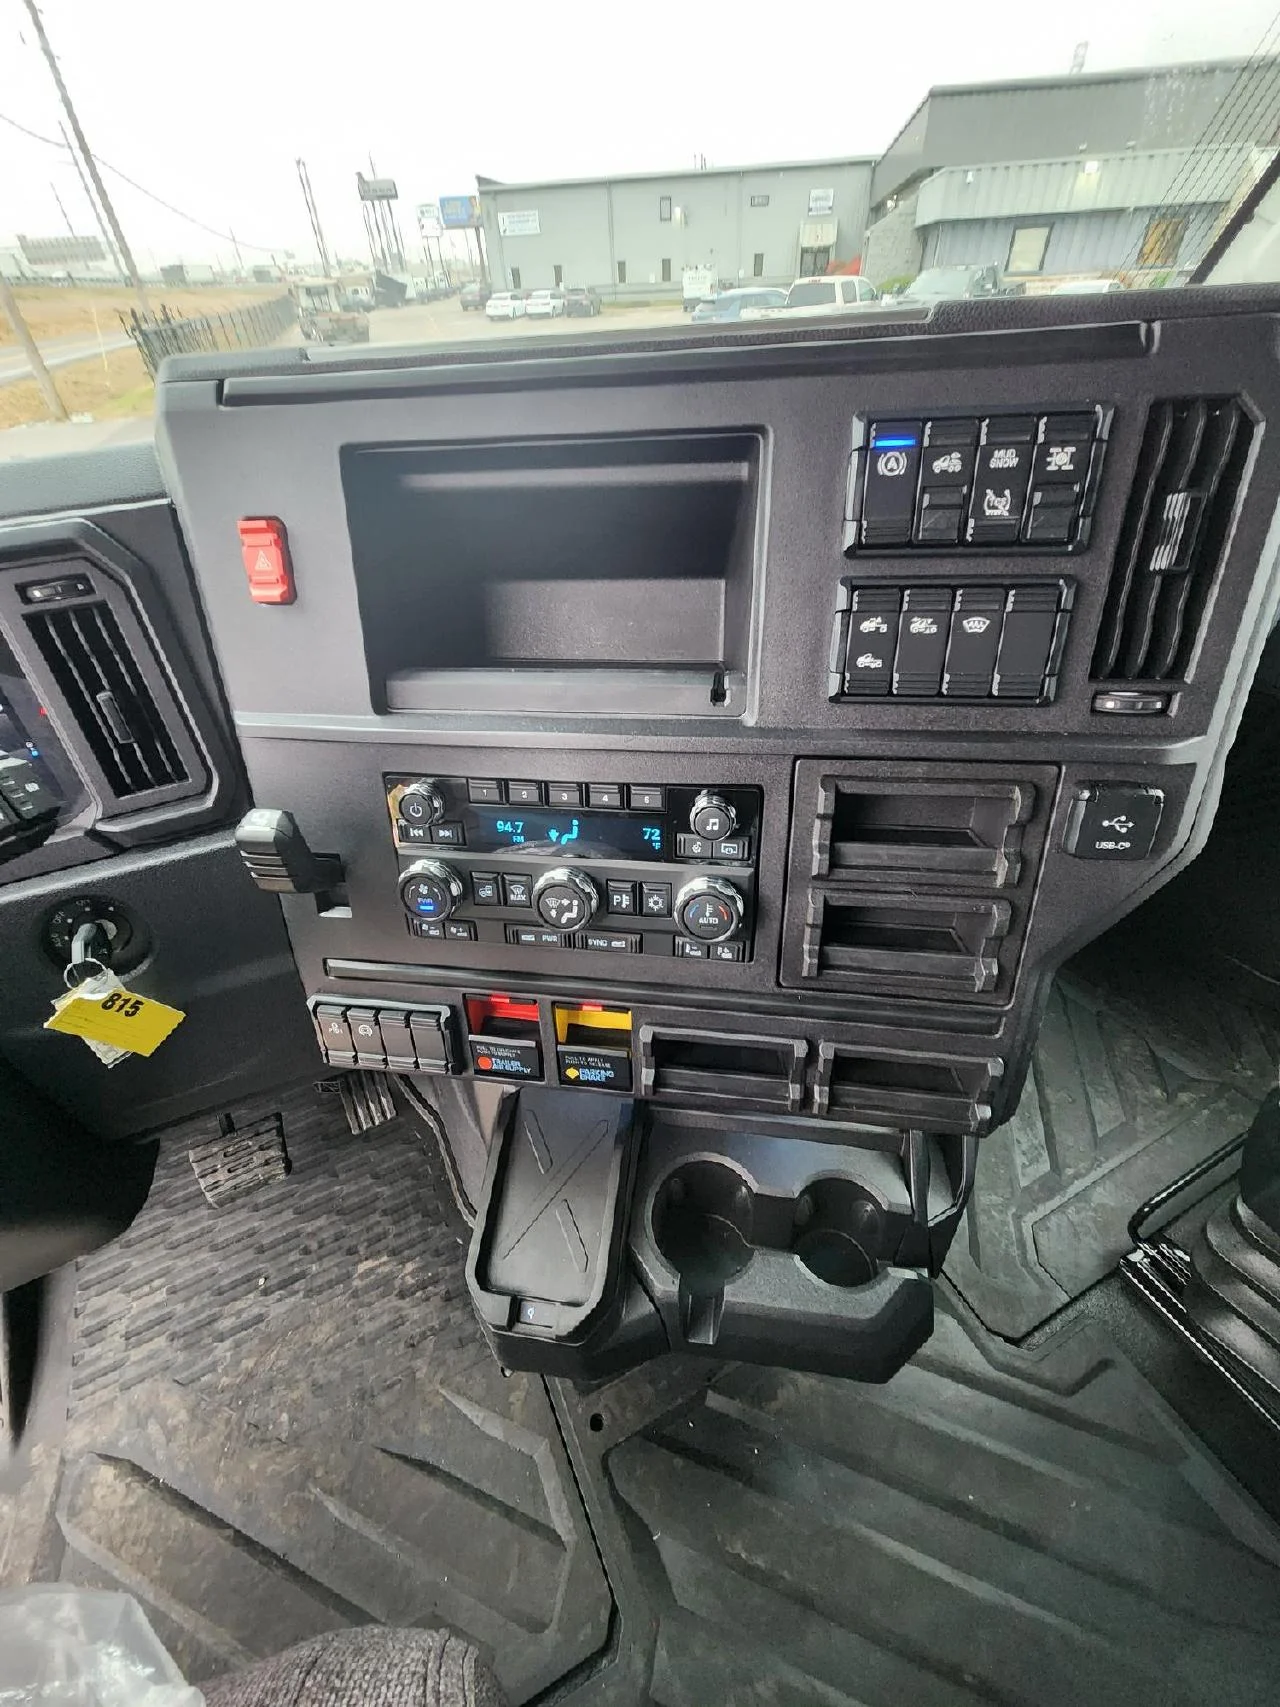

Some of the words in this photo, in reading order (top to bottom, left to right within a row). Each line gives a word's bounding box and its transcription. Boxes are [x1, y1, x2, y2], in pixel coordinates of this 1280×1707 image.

[993, 448, 1016, 458] MUD
[989, 457, 1020, 469] SNOW
[496, 820, 524, 833] 94.7
[642, 827, 661, 841] 72
[698, 917, 719, 925] AUTO
[542, 934, 558, 942] PWR
[587, 938, 608, 947] SYNC
[101, 992, 144, 1018] 815
[491, 1057, 521, 1067] TRAILER
[504, 1065, 532, 1074] SUPPLY
